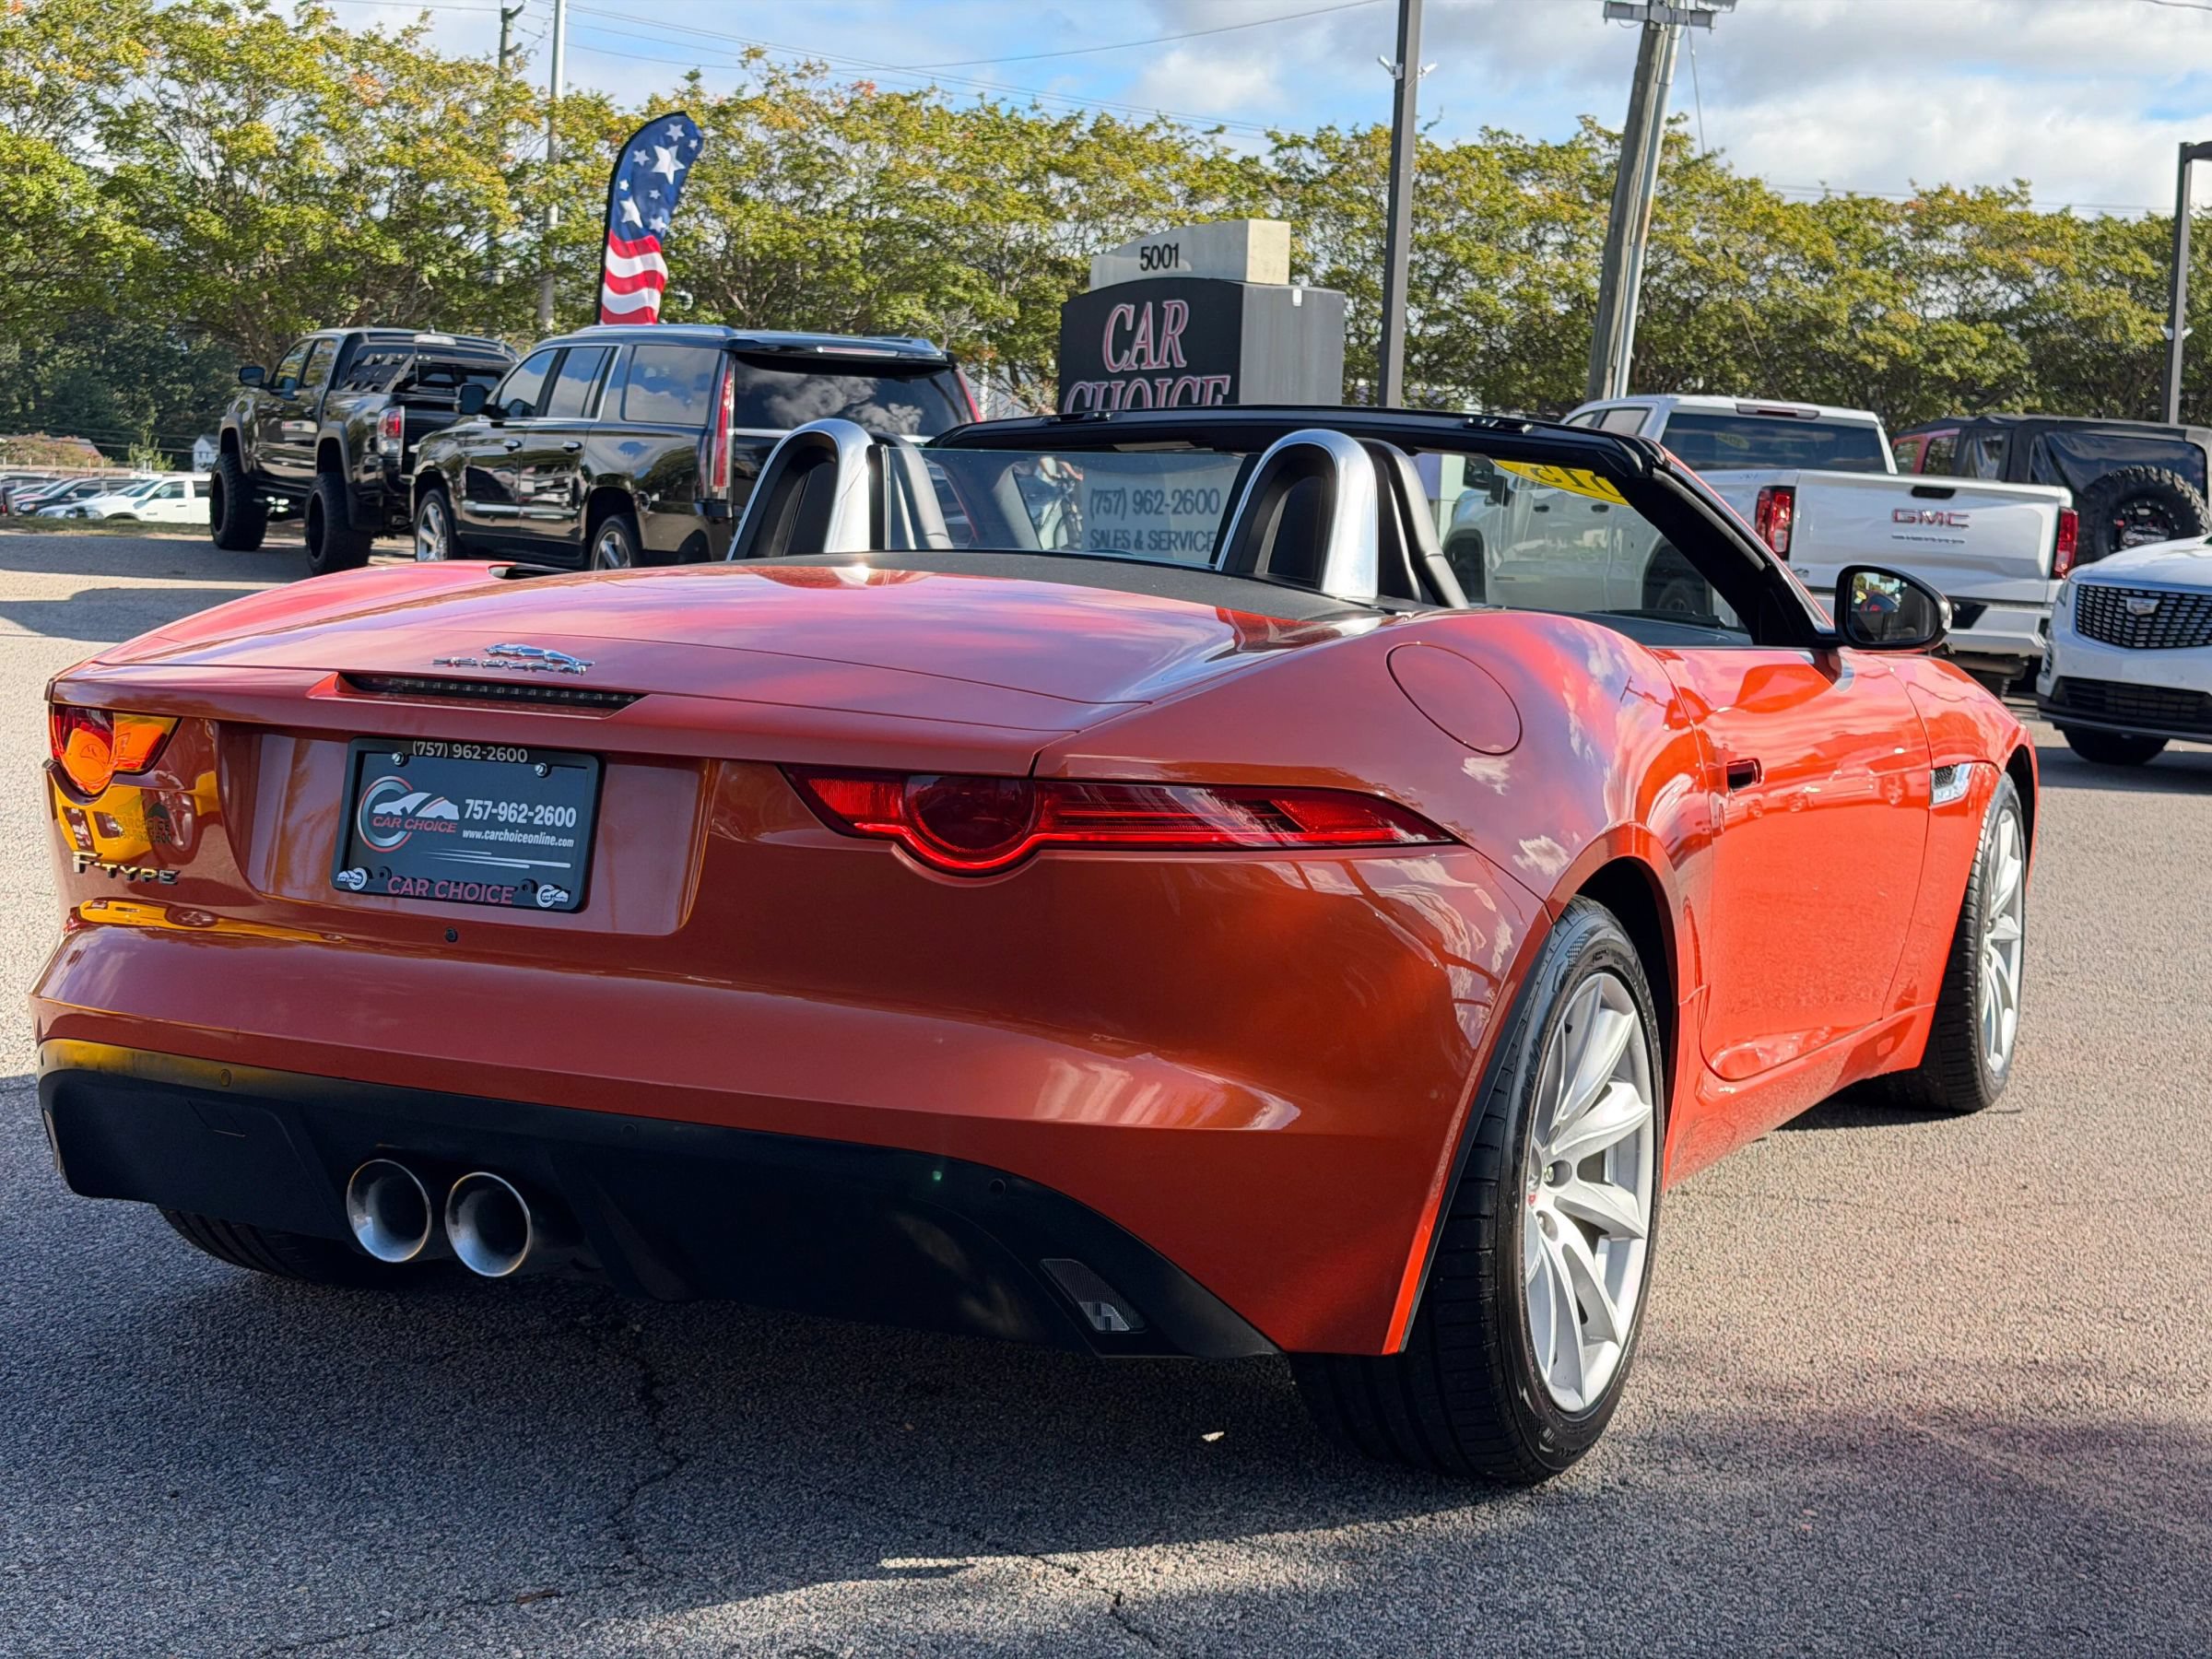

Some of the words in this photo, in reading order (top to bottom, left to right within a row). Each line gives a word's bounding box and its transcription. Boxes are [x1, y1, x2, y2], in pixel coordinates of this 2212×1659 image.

[1139, 243, 1180, 271] 5001
[1102, 300, 1190, 373] CAR
[1089, 487, 1127, 521] (757)
[1132, 488, 1220, 515] 962-2600
[1892, 508, 1971, 529] GMC
[1089, 529, 1132, 550] SALES
[1134, 530, 1144, 550] &
[412, 740, 448, 758] (757)
[453, 743, 528, 763] 962-2600
[372, 816, 402, 829] CAR
[404, 818, 457, 833] CHOICE
[464, 798, 577, 828] 757-962-2600
[463, 829, 574, 848] www.carchoiceonline.com
[72, 850, 182, 886] F-TYPE
[387, 877, 429, 897] CAR
[434, 880, 515, 904] CHOICE
